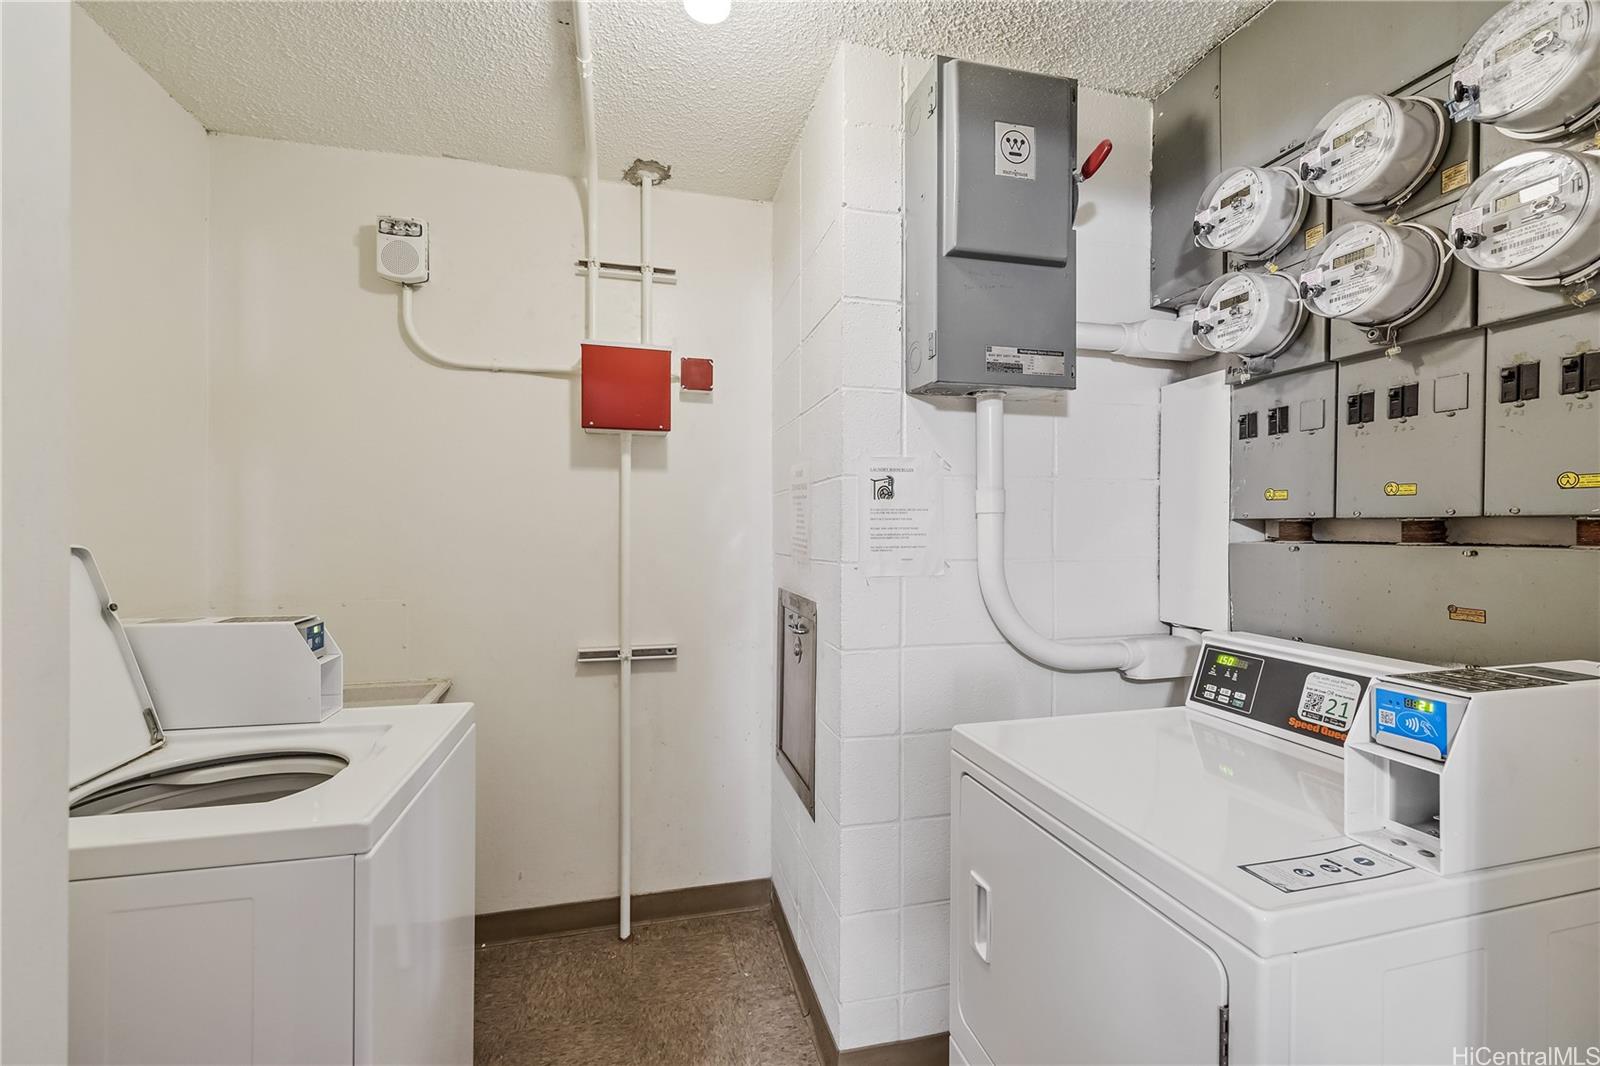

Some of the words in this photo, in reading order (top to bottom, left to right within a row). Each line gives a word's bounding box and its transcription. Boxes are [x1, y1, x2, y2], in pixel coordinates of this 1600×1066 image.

[1325, 698, 1349, 719] 21
[1288, 716, 1320, 733] Speed
[1320, 726, 1348, 740] Quee
